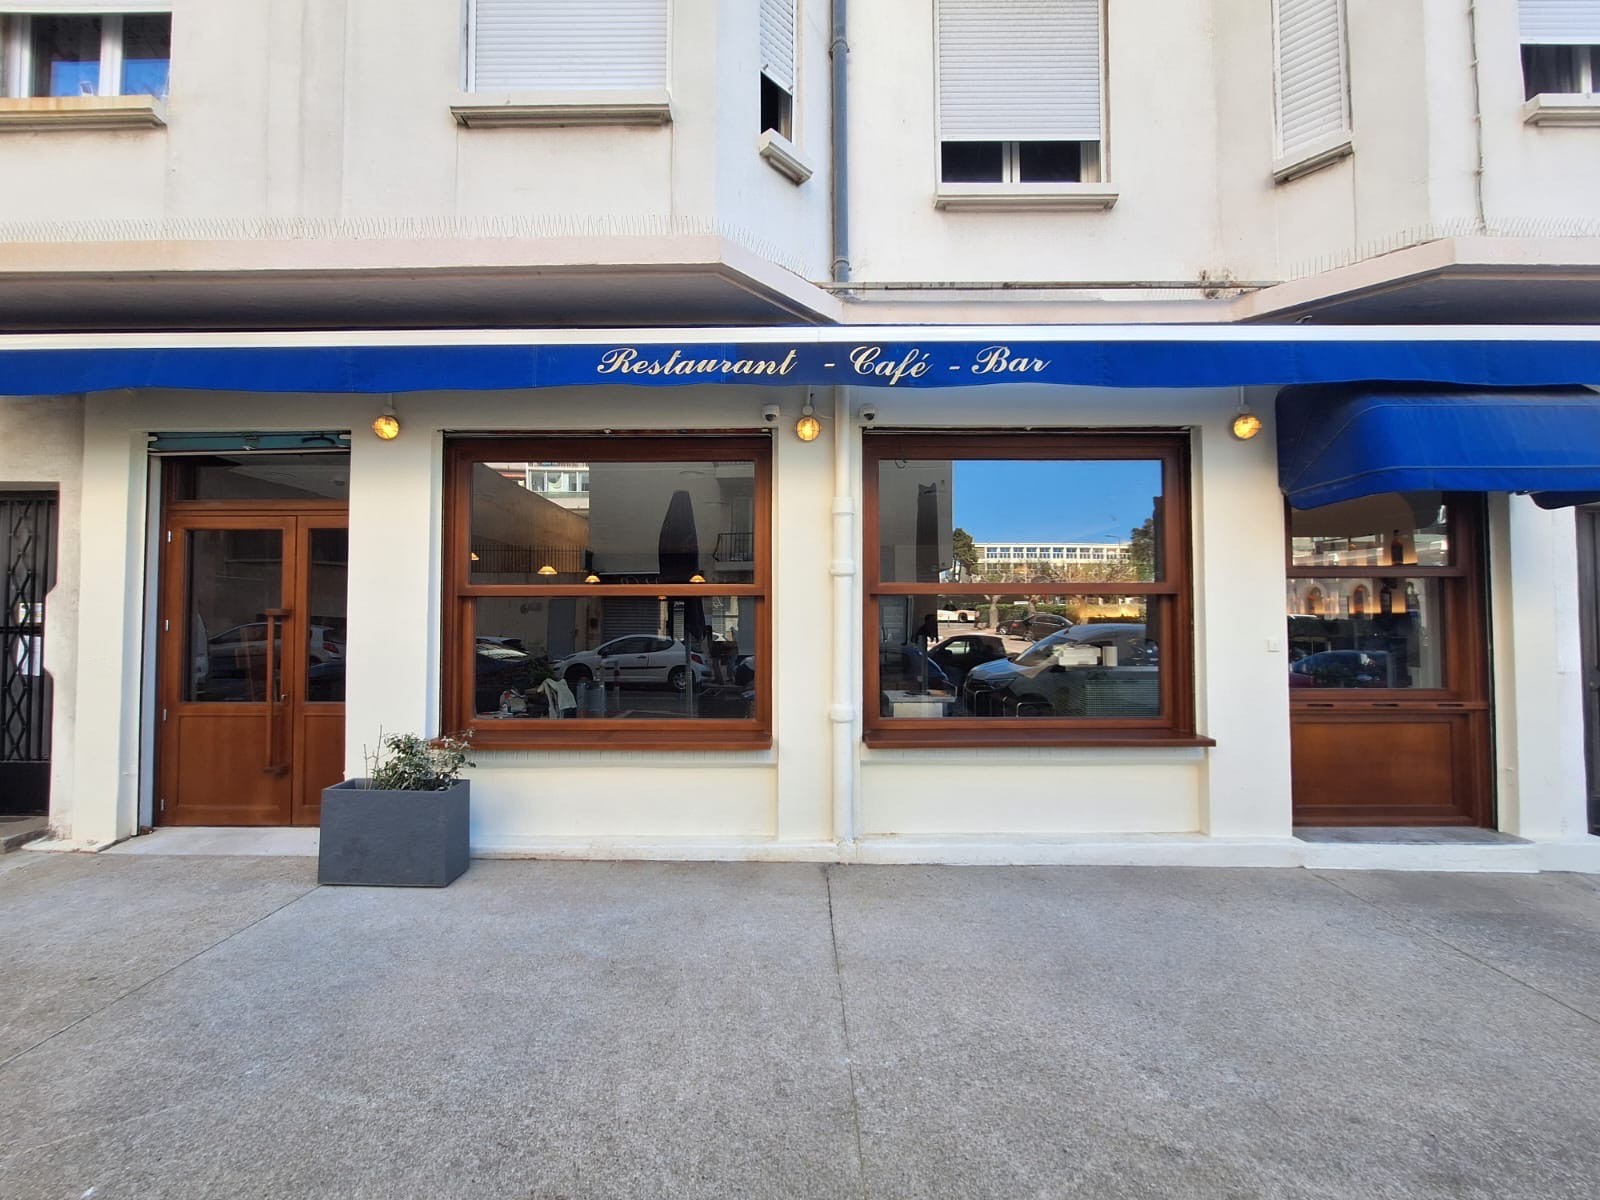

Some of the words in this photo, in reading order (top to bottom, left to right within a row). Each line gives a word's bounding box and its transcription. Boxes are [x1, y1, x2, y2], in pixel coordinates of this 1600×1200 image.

[596, 347, 798, 375] Restaurant
[849, 346, 932, 386] Café
[971, 345, 1051, 374] Bar
